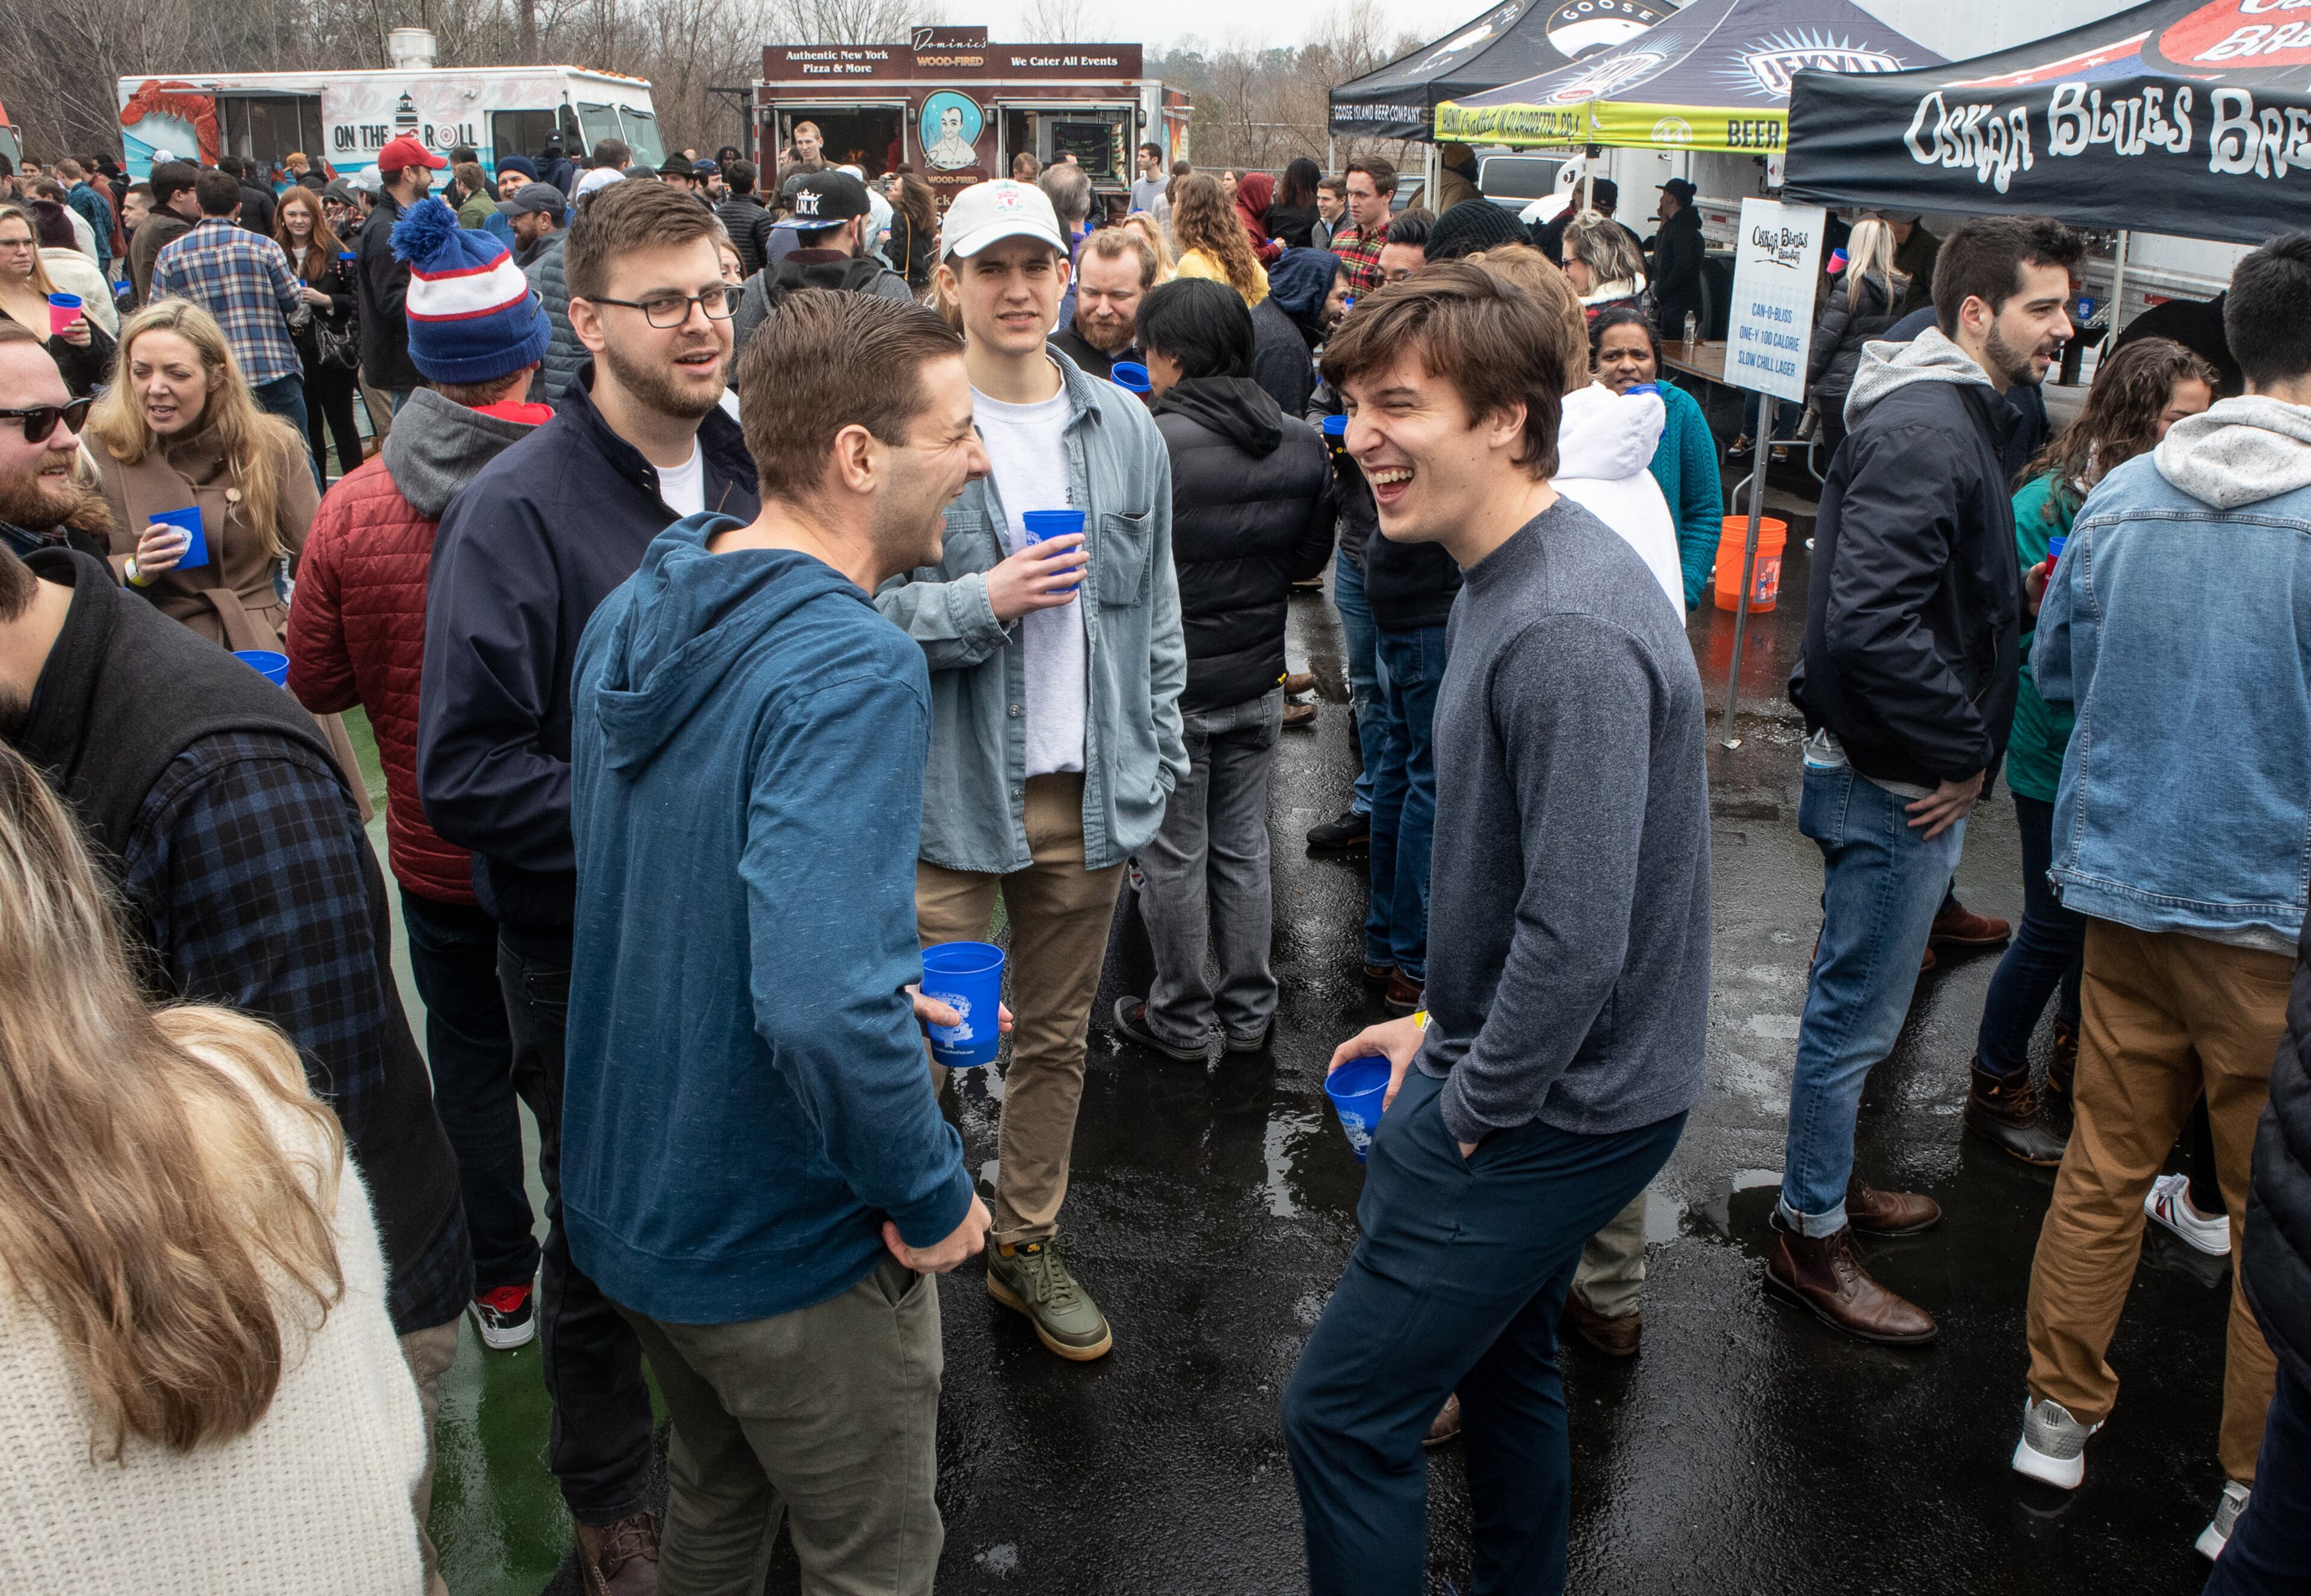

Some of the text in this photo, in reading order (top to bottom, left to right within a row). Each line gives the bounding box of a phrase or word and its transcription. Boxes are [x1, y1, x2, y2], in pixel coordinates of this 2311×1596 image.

[1562, 0, 1654, 20] GOOSE
[912, 28, 987, 51] Dominic's
[786, 50, 889, 60] Authentic New York
[917, 56, 985, 67] WOOD-FIRED
[1011, 57, 1118, 66] We Cater All Events
[803, 64, 872, 73] Pizza & More
[1334, 104, 1422, 123] GOOSE ISLAND BEER COMPANY
[334, 125, 356, 149] ON
[359, 125, 389, 149] THE
[1727, 119, 1781, 149] BEER
[1903, 90, 2034, 194] OSKAR
[2047, 82, 2194, 156] BLUES
[927, 176, 978, 184] WOOD-FIRED
[1781, 227, 1808, 248] BLUES
[1752, 303, 1793, 324] CAN-O-BLISS
[1739, 326, 1800, 351] ONE-Y 100 CALORIE
[1738, 350, 1796, 377] SLOW CHILL LAGER
